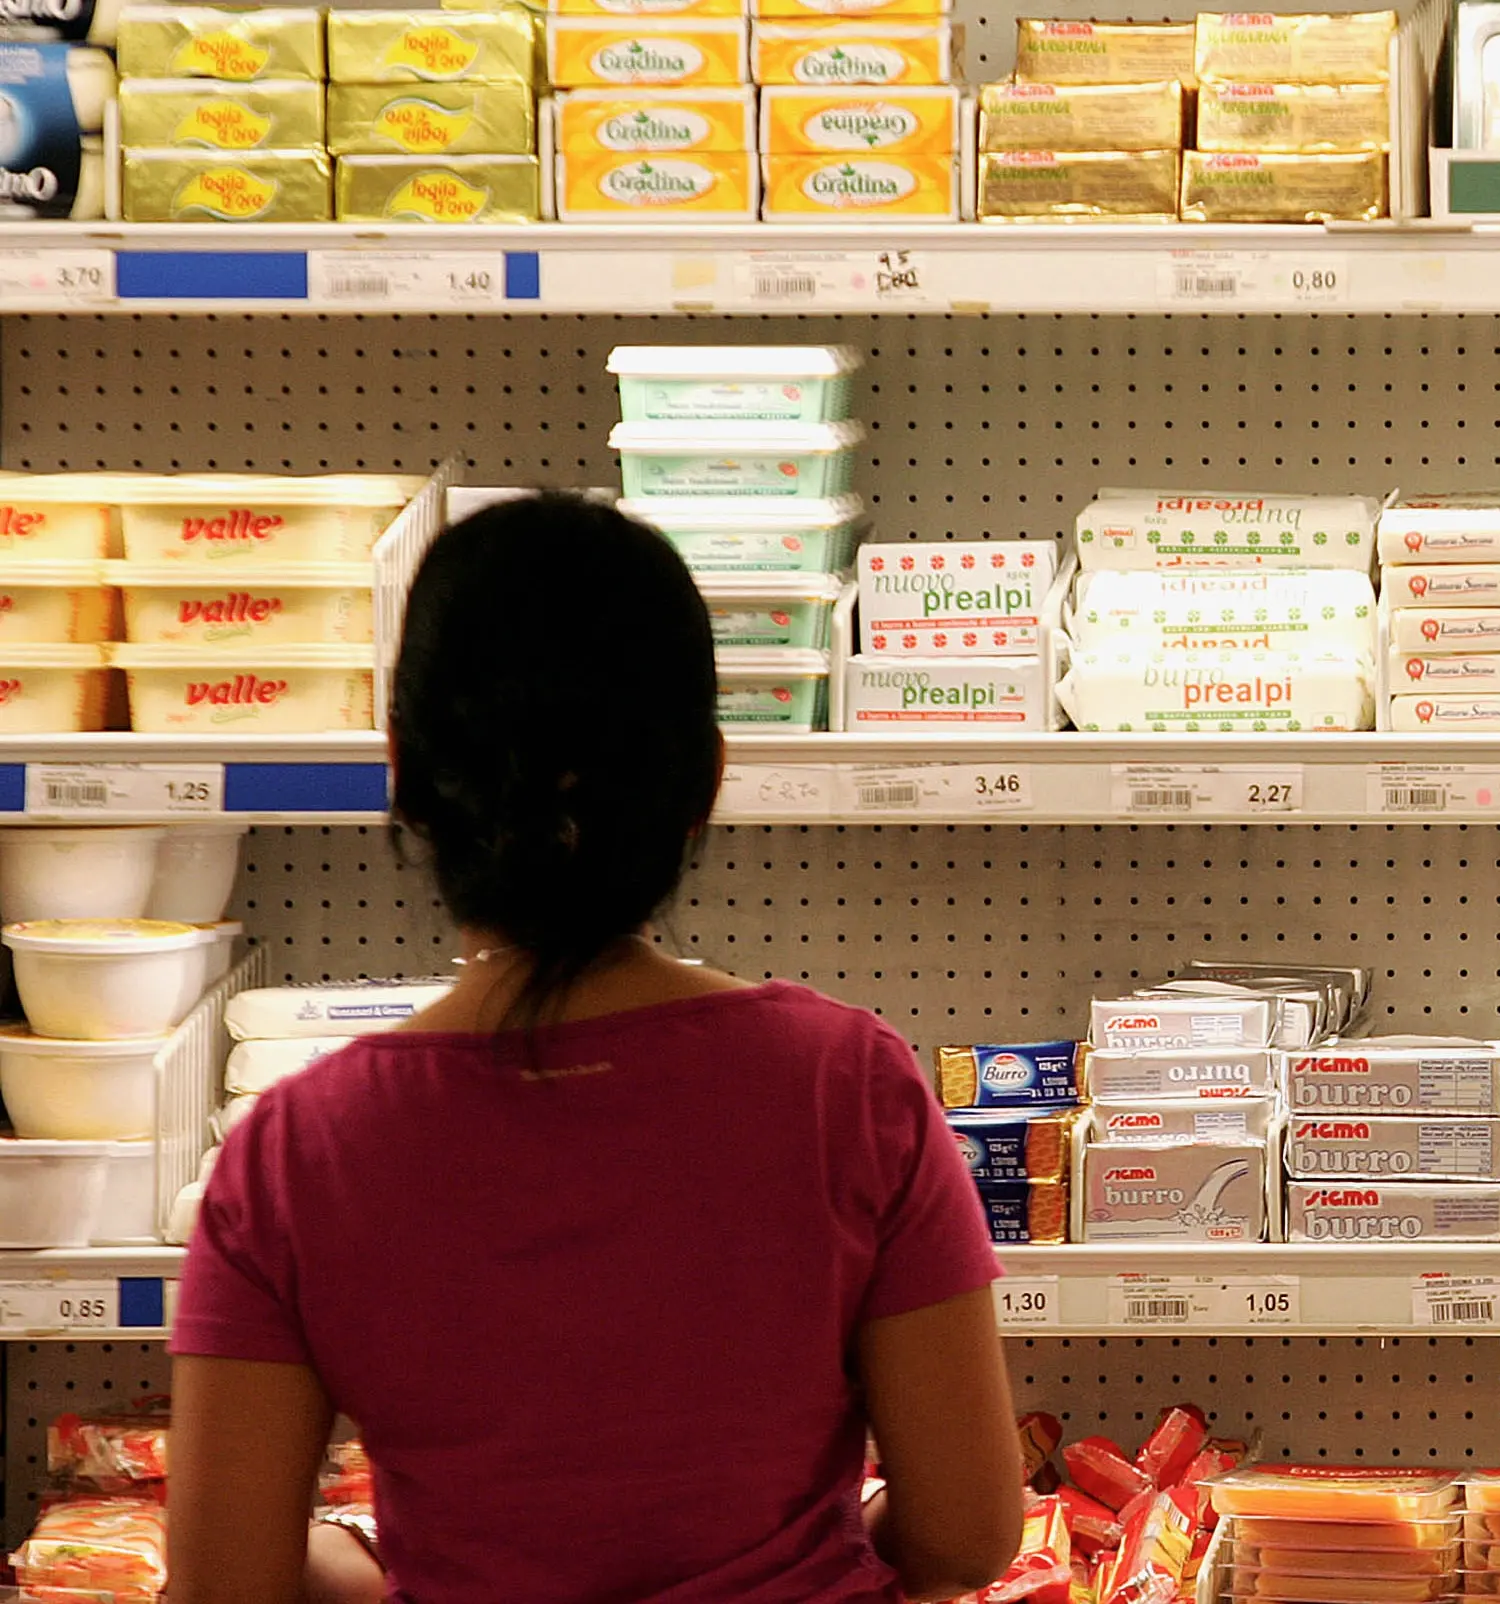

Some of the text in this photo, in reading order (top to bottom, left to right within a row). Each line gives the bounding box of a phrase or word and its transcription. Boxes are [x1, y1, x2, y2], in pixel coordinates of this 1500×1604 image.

[600, 47, 684, 72] Gradina
[802, 53, 887, 76] Gradina
[606, 117, 691, 141] Gradina
[821, 114, 906, 138] Gradina
[609, 169, 695, 193] Gradina
[812, 171, 897, 194] Gradina
[446, 271, 490, 292] 1,40
[1292, 270, 1337, 291] 0,80
[1156, 498, 1264, 514] prealpi
[874, 572, 955, 594] nuovo
[923, 584, 1031, 617] prealpi
[862, 671, 930, 688] nuovo
[903, 683, 995, 709] prealpi
[1184, 677, 1292, 709] prealpi
[166, 782, 209, 802] 1,25
[975, 774, 1020, 795] 3,46
[1248, 784, 1292, 804] 2,27
[1107, 1031, 1189, 1049] burro
[983, 1066, 1027, 1081] Burro
[1168, 1063, 1250, 1082] burro
[1295, 1078, 1412, 1106] burro
[1295, 1144, 1412, 1173] burro
[1105, 1187, 1184, 1205] burro
[1305, 1211, 1423, 1239] burro
[60, 1299, 105, 1319] 0,85
[1002, 1292, 1046, 1313] 1,30
[1246, 1293, 1290, 1313] 1,05
